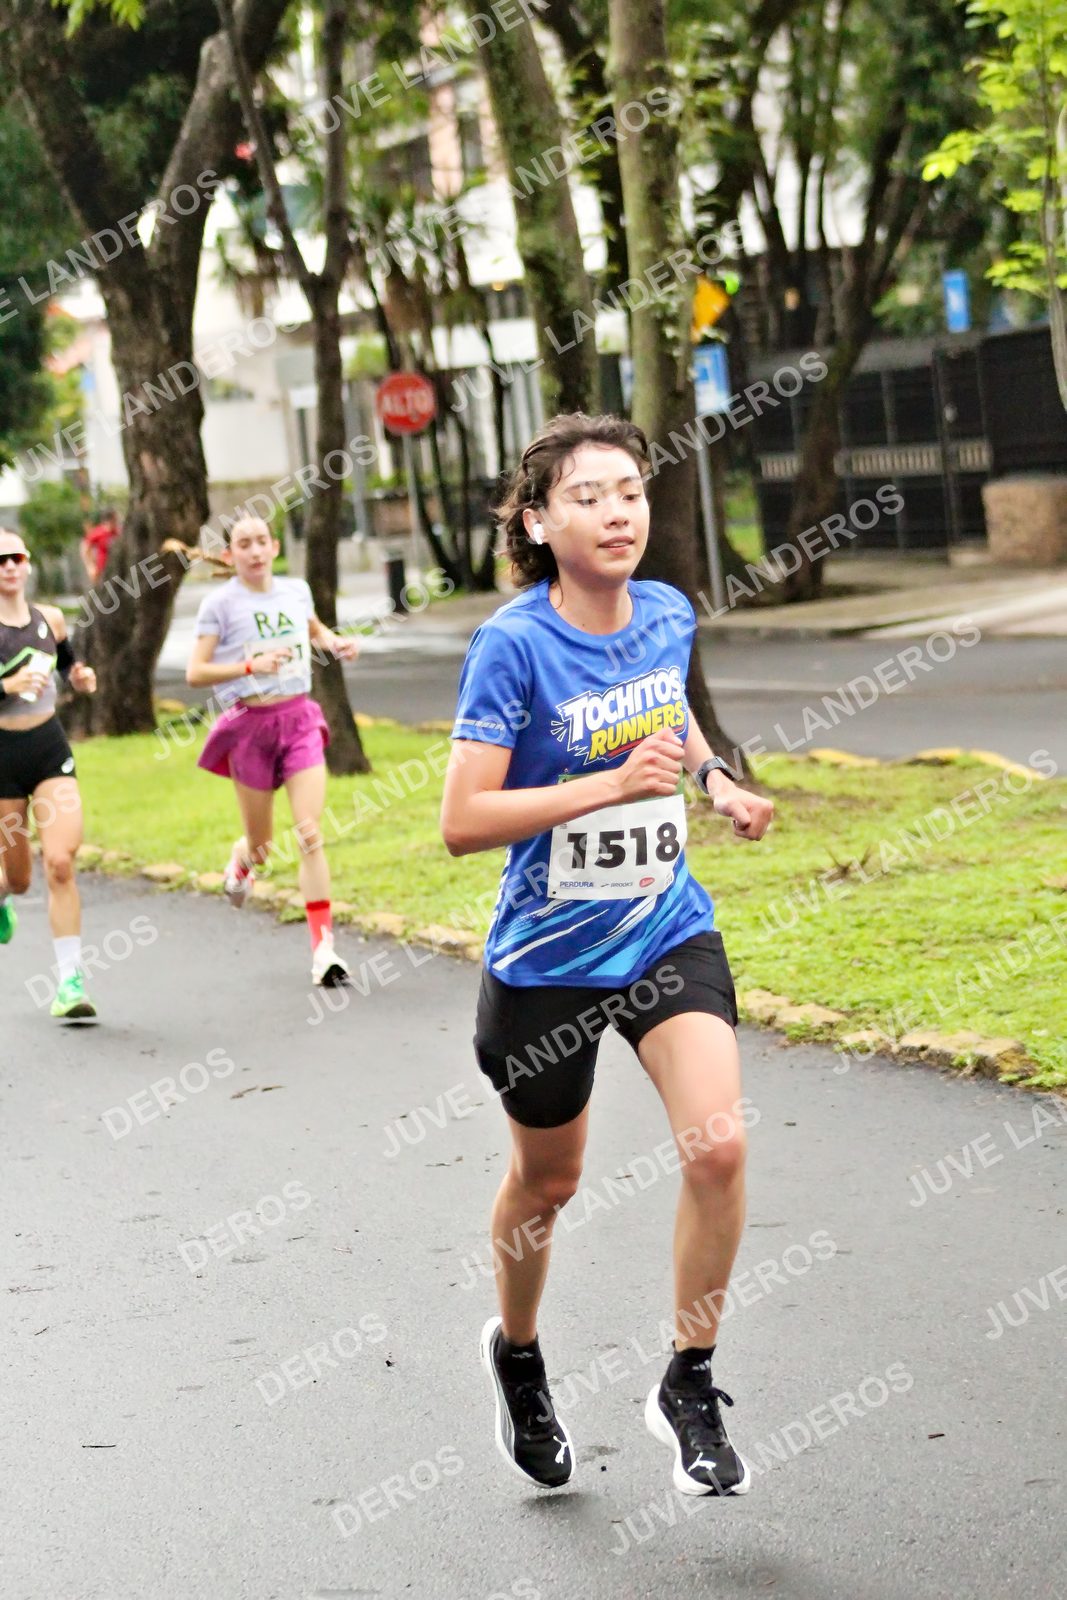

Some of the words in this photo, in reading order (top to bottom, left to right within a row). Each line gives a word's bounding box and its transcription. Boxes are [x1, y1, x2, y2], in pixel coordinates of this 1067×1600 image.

[382, 389, 433, 416] ALTO
[254, 611, 295, 638] RA
[562, 668, 681, 744] TOCHITOS
[589, 700, 685, 761] RUNNERS
[567, 822, 680, 869] 1518
